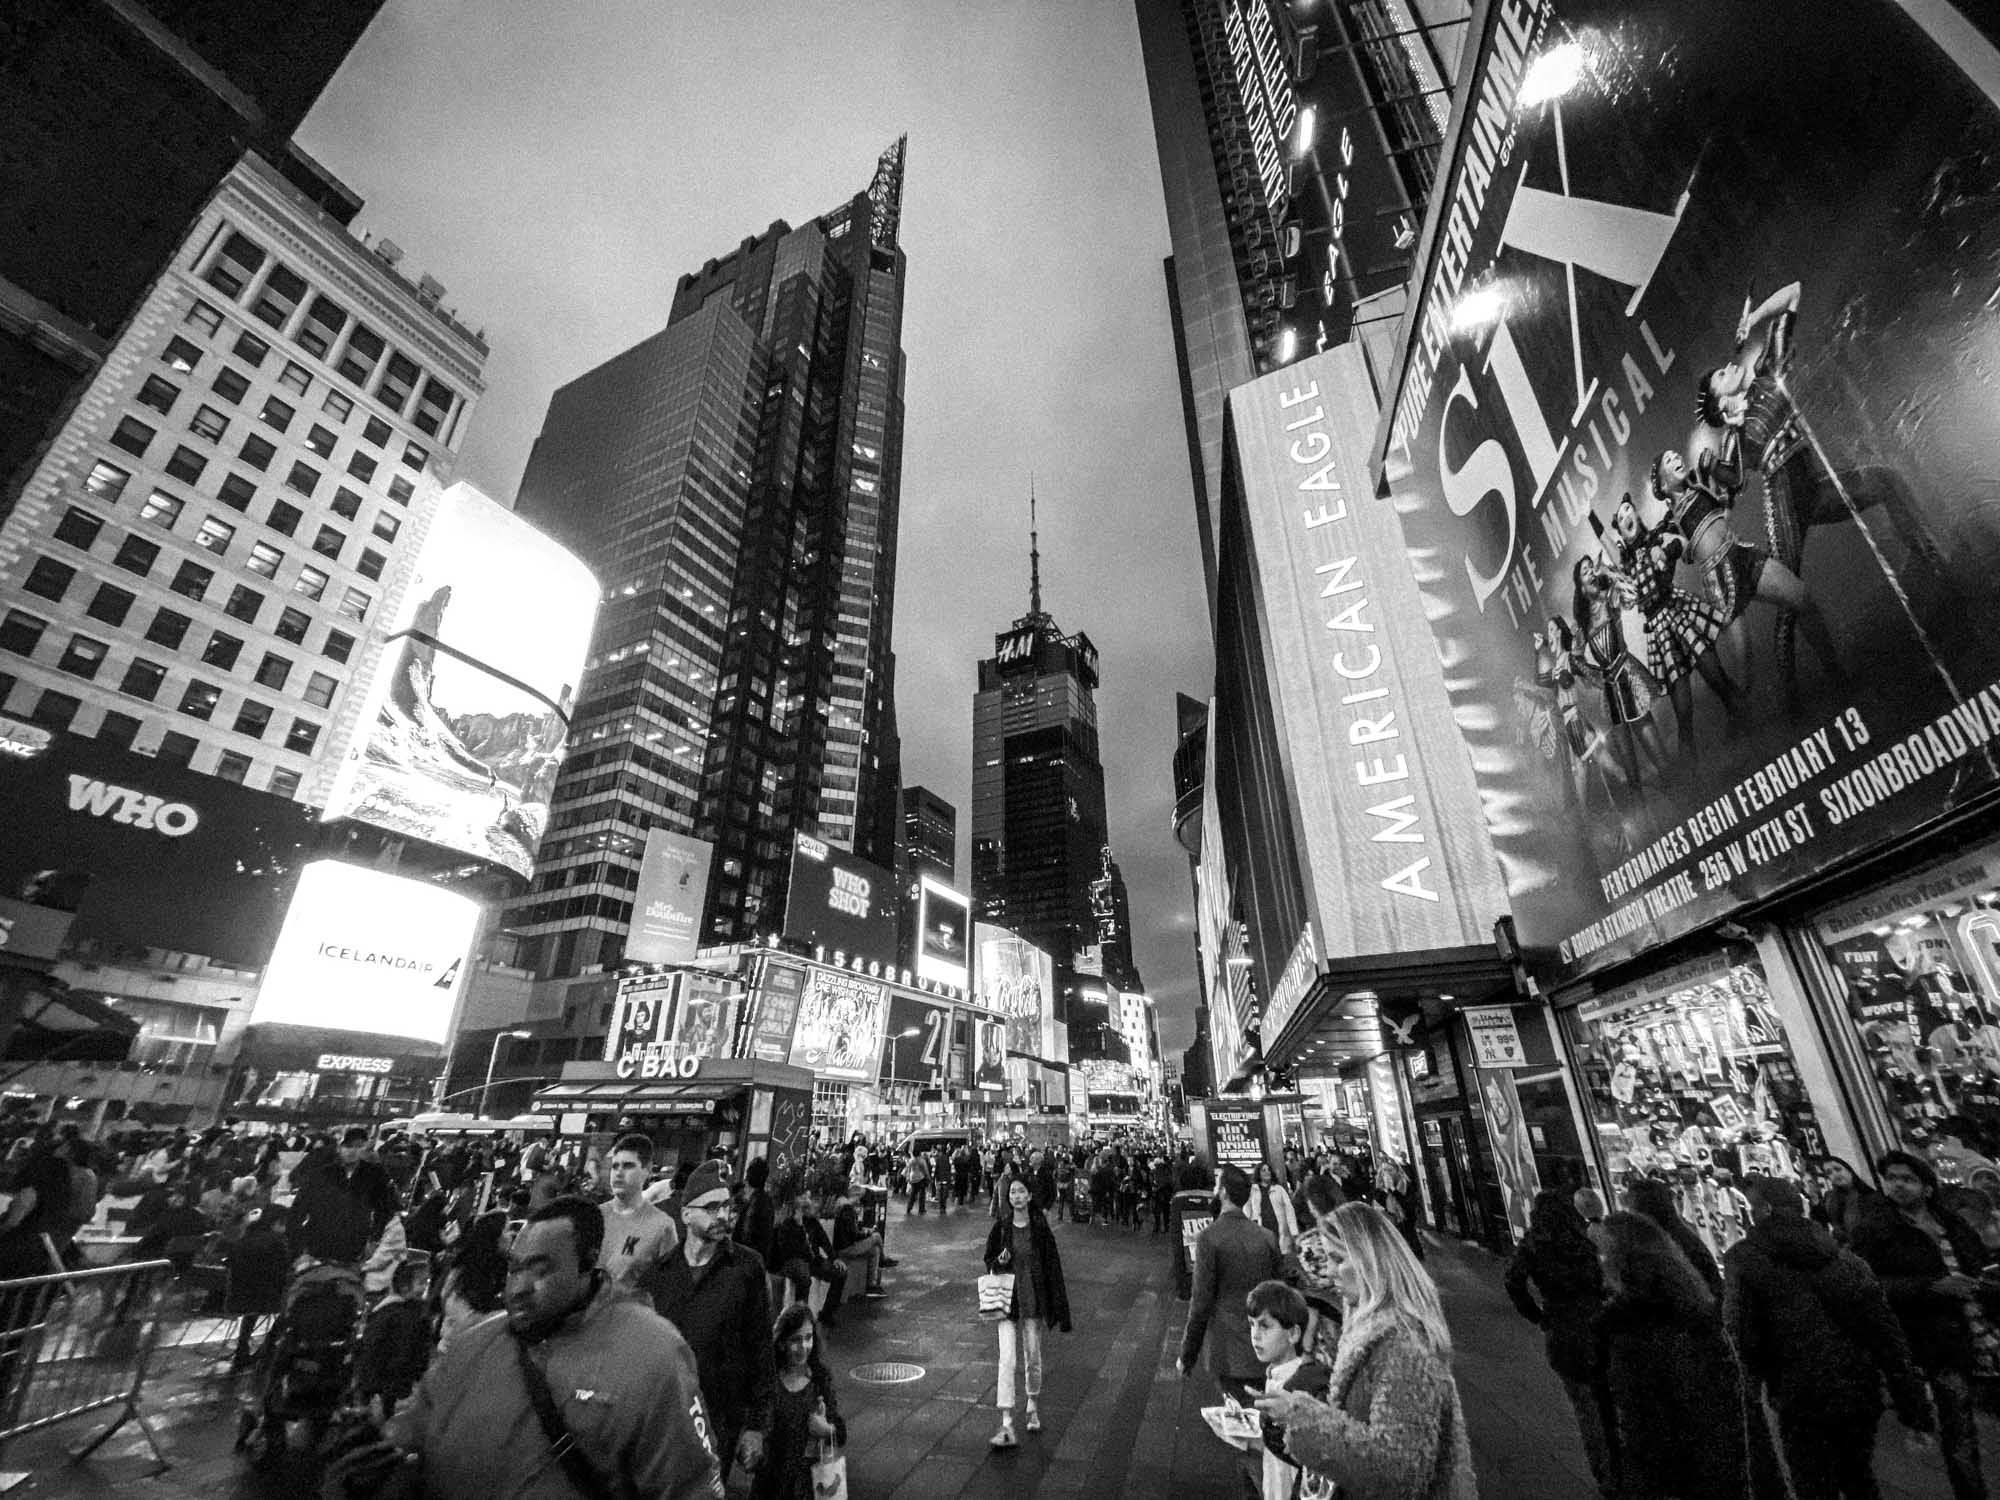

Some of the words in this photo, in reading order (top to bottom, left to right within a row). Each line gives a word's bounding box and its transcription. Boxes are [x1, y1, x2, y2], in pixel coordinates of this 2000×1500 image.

[1241, 63, 1286, 209] AMERICAN
[1421, 0, 1542, 373] ENTERTAINME
[1437, 70, 1693, 615] SIX
[1280, 380, 1347, 530] EAGLE
[1502, 542, 1544, 630] THE
[1541, 319, 1676, 561] MUSICAL
[1313, 554, 1440, 903] AMERICAN
[68, 773, 199, 837] WHO
[1600, 825, 1691, 903] PERFORMANCES
[1687, 793, 1739, 848] BEGIN
[1734, 726, 1836, 818] FEBRUARY
[1834, 706, 1871, 752] 13
[828, 886, 870, 919] SHOT
[832, 866, 870, 898] WHO
[1570, 921, 1606, 960] BROOKS
[1601, 897, 1650, 944] ATKINSON
[1643, 869, 1698, 920] THEATRE
[1698, 850, 1732, 891] 256
[1725, 840, 1749, 876] W
[1745, 816, 1792, 866] 47TH
[1784, 801, 1816, 845] ST
[318, 942, 434, 972] ICELANDAIR
[815, 945, 880, 978] 1540
[317, 1054, 395, 1073] EXPRESS
[640, 1053, 700, 1079] BAO
